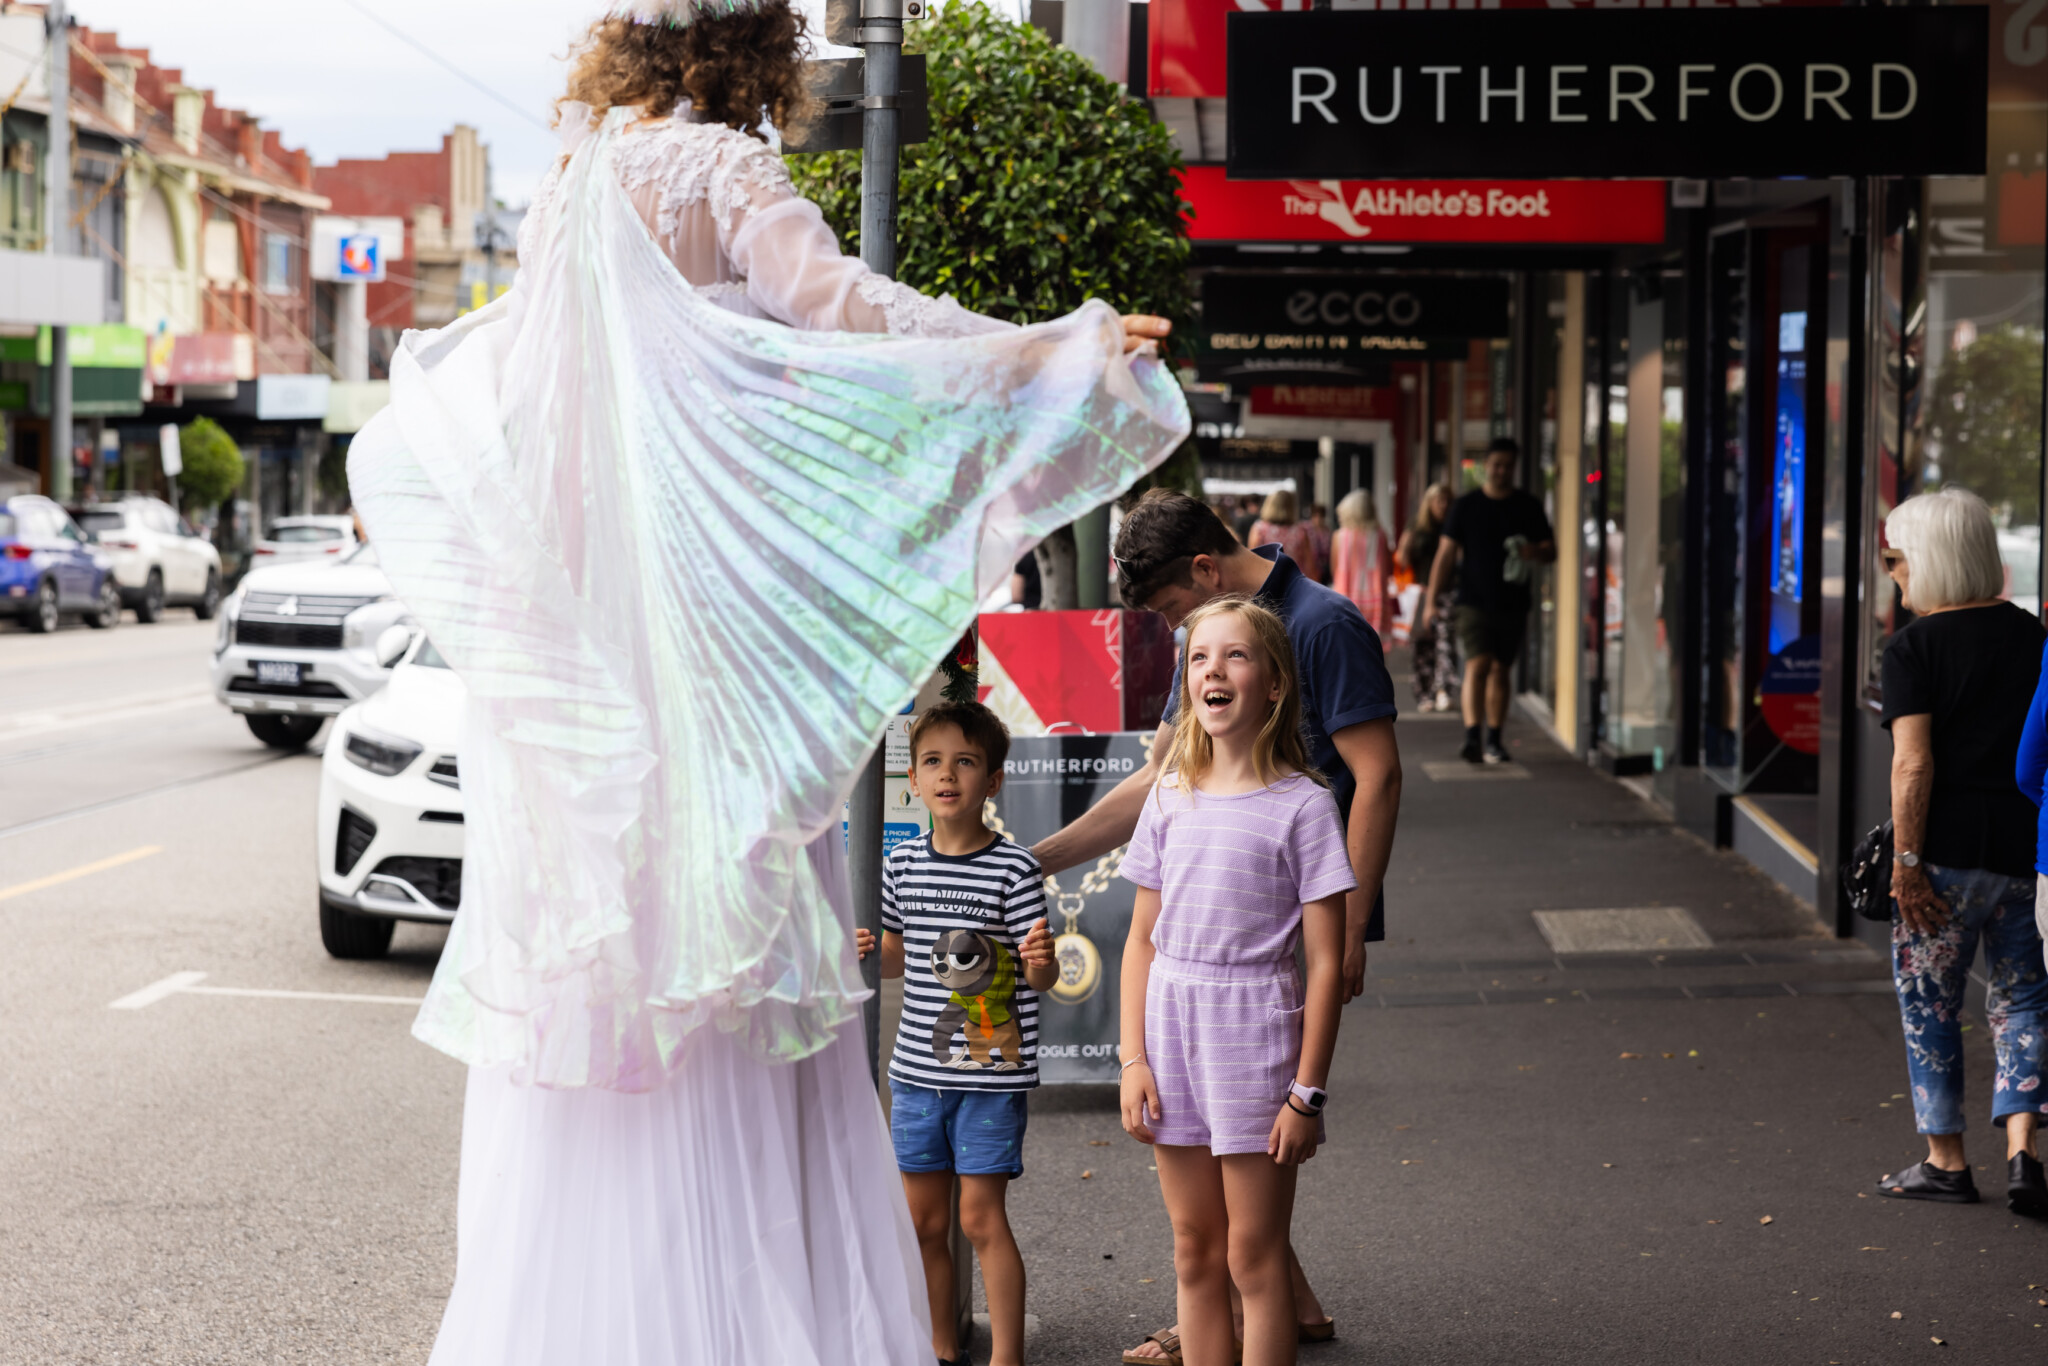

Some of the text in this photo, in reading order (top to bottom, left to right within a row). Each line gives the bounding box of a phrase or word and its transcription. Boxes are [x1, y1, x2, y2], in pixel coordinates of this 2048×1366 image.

[1291, 62, 1919, 125] RUTHERFORD
[1283, 187, 1551, 218] The Athlete's Foot
[1286, 290, 1421, 326] ecco
[1003, 757, 1135, 775] RUTHERFORD
[1081, 1044, 1113, 1058] OUT
